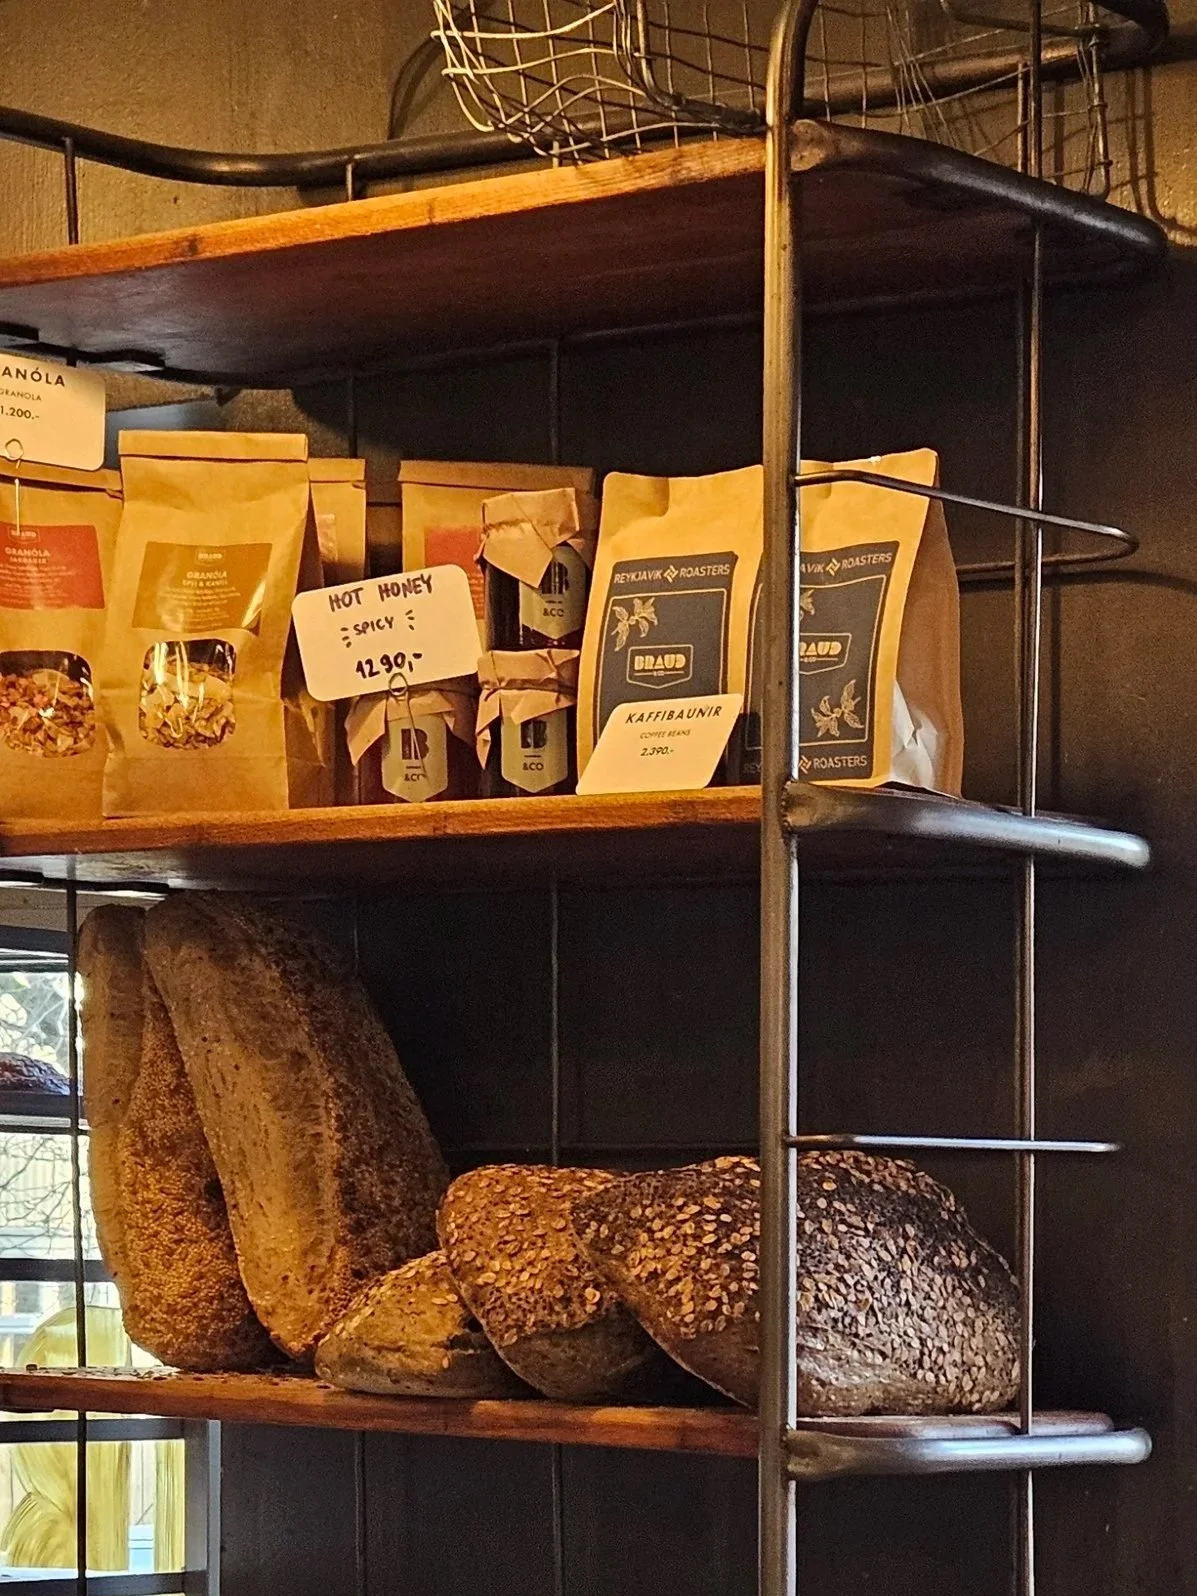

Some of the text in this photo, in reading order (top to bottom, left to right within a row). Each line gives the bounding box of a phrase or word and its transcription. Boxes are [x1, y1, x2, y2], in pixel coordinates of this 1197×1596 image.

[2, 366, 65, 387] ANÓLA
[841, 552, 893, 571] ROASTERS
[679, 564, 731, 579] ROASTERS
[328, 573, 432, 612] HOT HONEY
[353, 616, 394, 635] SPICY
[799, 641, 842, 656] RAUD
[625, 705, 723, 724] KAFFIBAUNIR
[640, 728, 692, 739] COFFEE BEANS
[813, 755, 868, 769] ROASTERS
